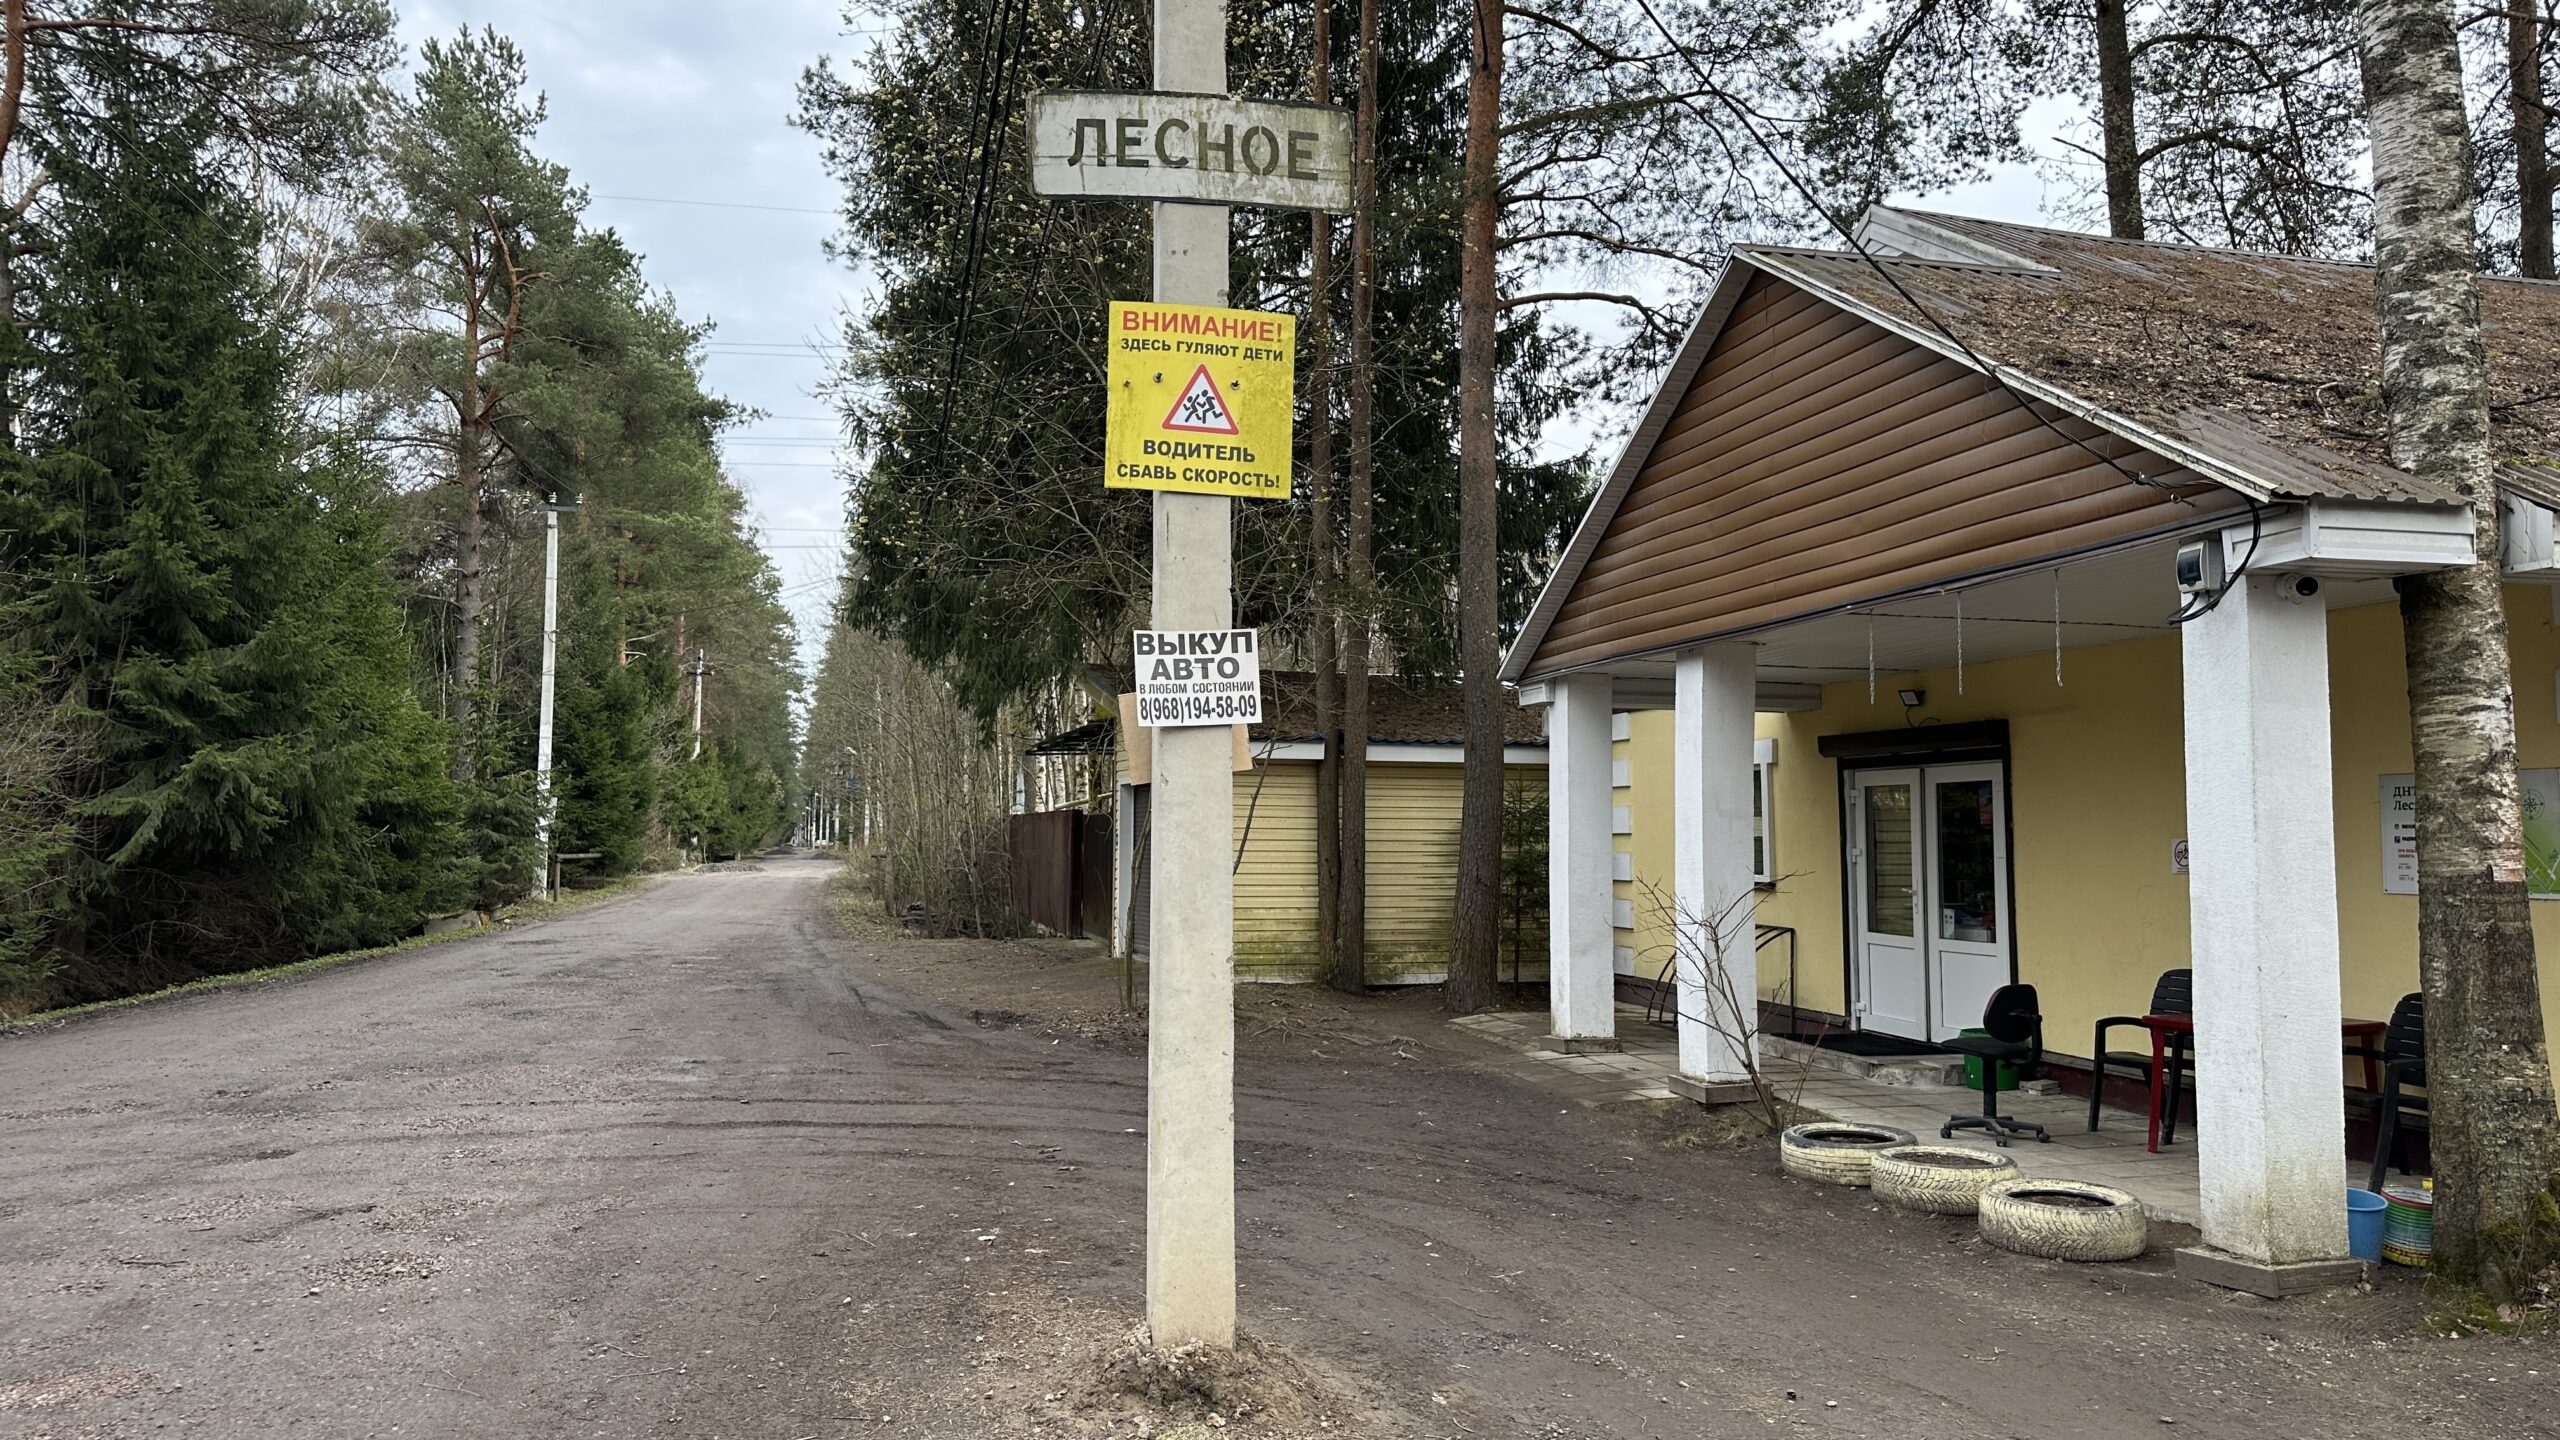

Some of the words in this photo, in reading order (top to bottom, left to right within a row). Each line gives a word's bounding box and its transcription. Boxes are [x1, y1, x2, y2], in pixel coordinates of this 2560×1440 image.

[1067, 118, 1319, 181] ЛЕСНОЕ
[1122, 310, 1282, 343] ВНИМАНИЕ!
[1120, 338, 1171, 352] ЗДЕСЬ
[1176, 341, 1239, 357] ГУЛЯЮТ
[1243, 347, 1283, 362] ДЕТИ
[1143, 440, 1256, 463] ВОДИТЕЛЬ
[1117, 463, 1176, 480] СБАВЬ
[1182, 468, 1280, 488] СКОРОСТЬ!
[1136, 631, 1253, 655] ВЫКУП
[1150, 657, 1240, 680] АВТО
[1139, 684, 1146, 694] В
[1149, 683, 1187, 694] ЛЮБОМ
[1192, 681, 1254, 693] СОСТОЯНИИ
[1140, 694, 1257, 724] 8(968)194-58-09
[2393, 800, 2416, 811] Лес
